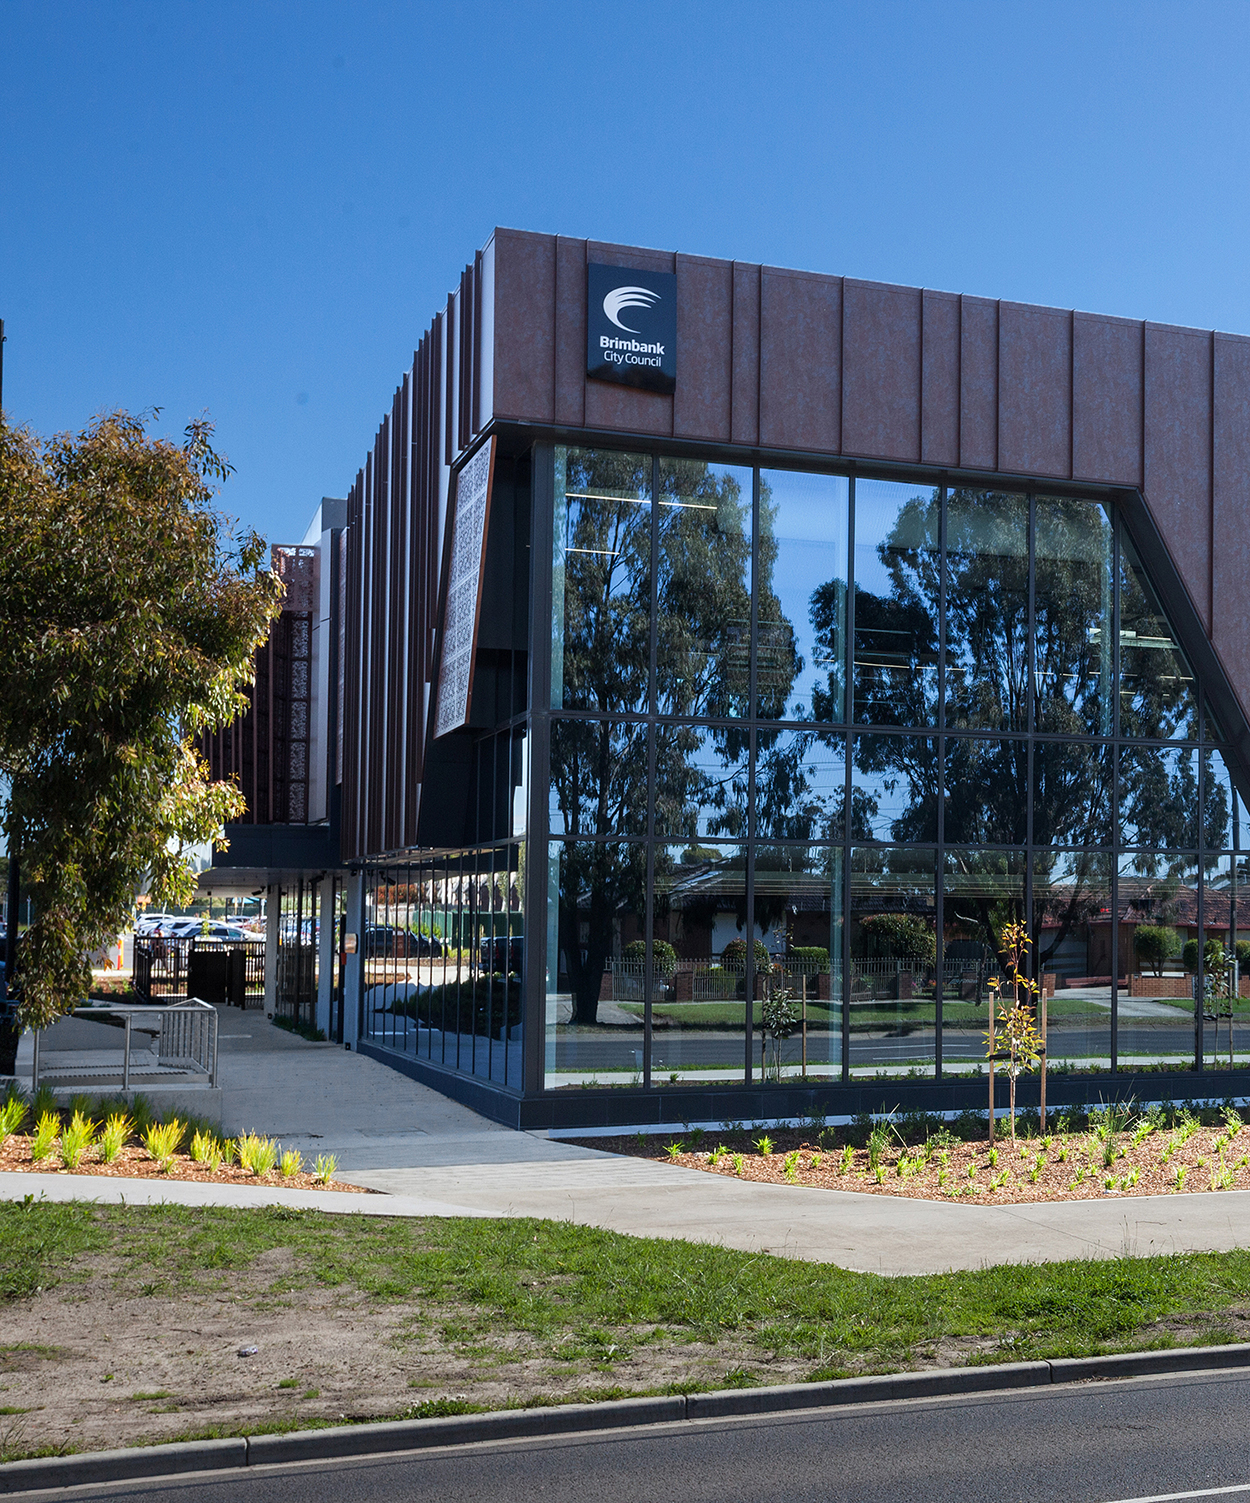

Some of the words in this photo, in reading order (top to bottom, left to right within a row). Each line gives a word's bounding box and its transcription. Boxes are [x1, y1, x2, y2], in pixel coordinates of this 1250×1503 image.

[600, 335, 665, 355] Brimbank
[603, 350, 624, 365] City
[625, 353, 661, 367] Council
